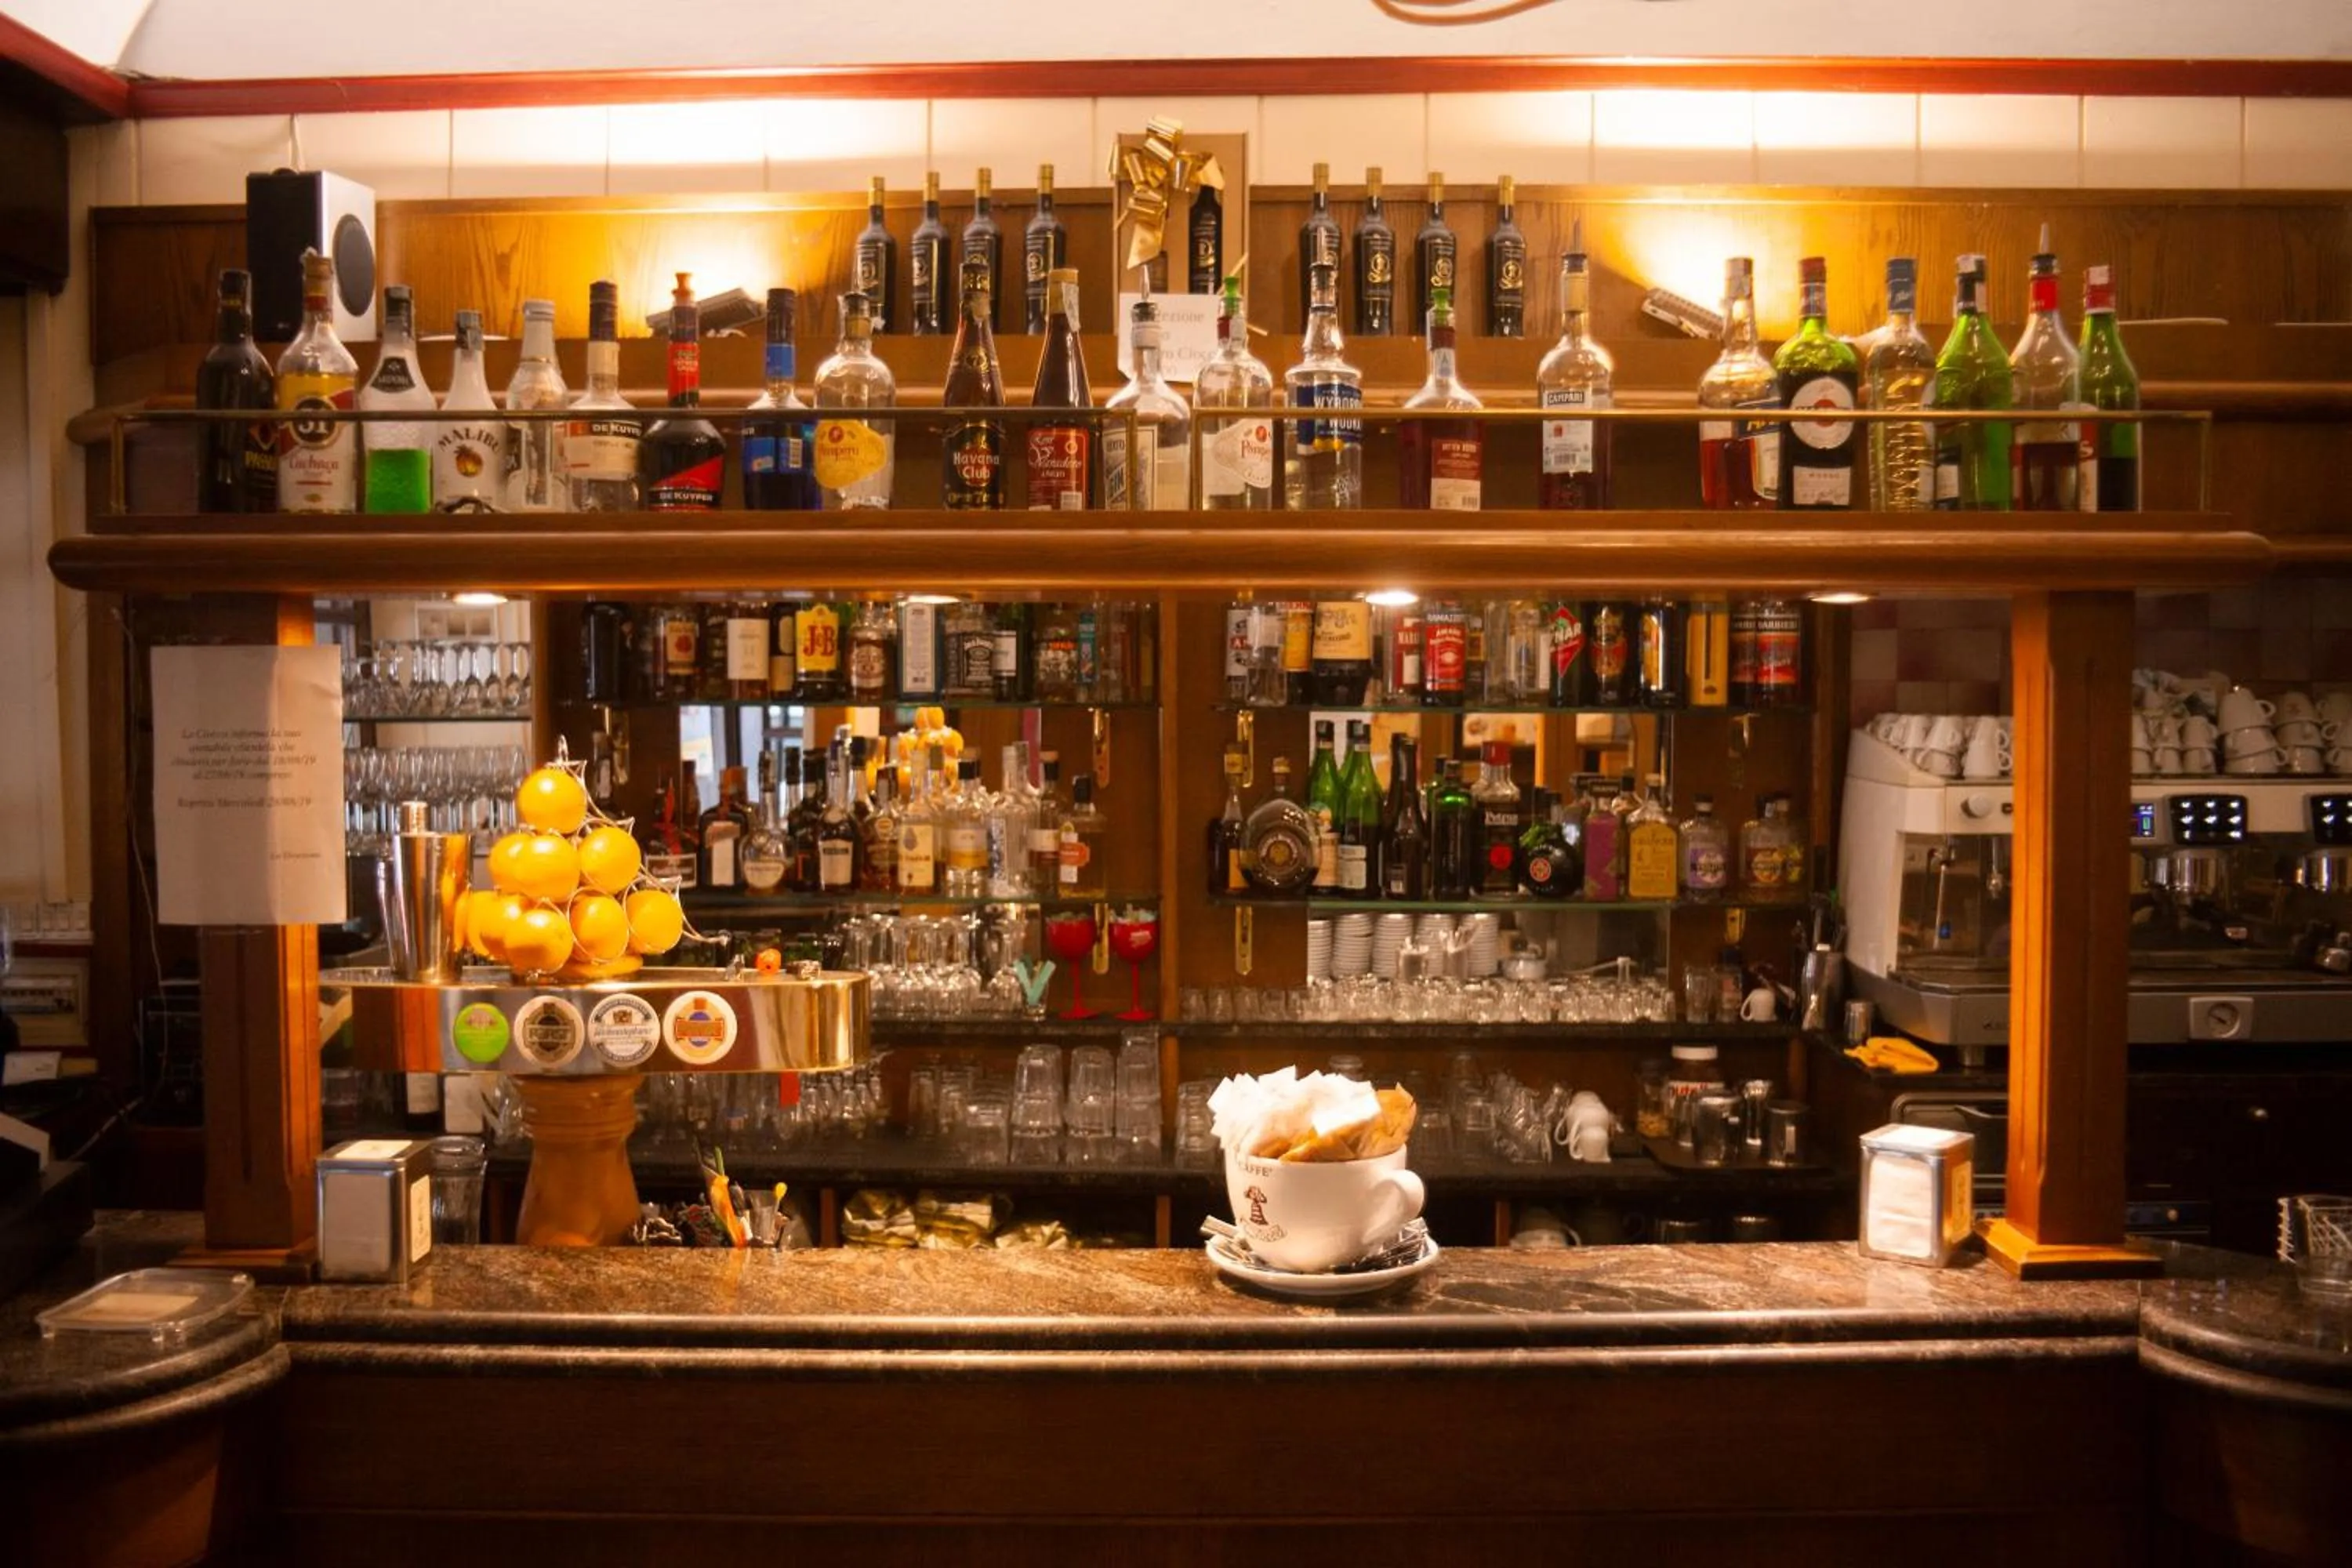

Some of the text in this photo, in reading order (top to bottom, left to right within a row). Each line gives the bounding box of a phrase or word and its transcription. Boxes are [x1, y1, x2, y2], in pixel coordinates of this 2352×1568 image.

[1548, 393, 1584, 405] CAMPARI
[437, 427, 503, 454] MALIBU
[953, 452, 1000, 465] Havana
[963, 466, 990, 479] Club
[675, 491, 713, 503] KUYPER
